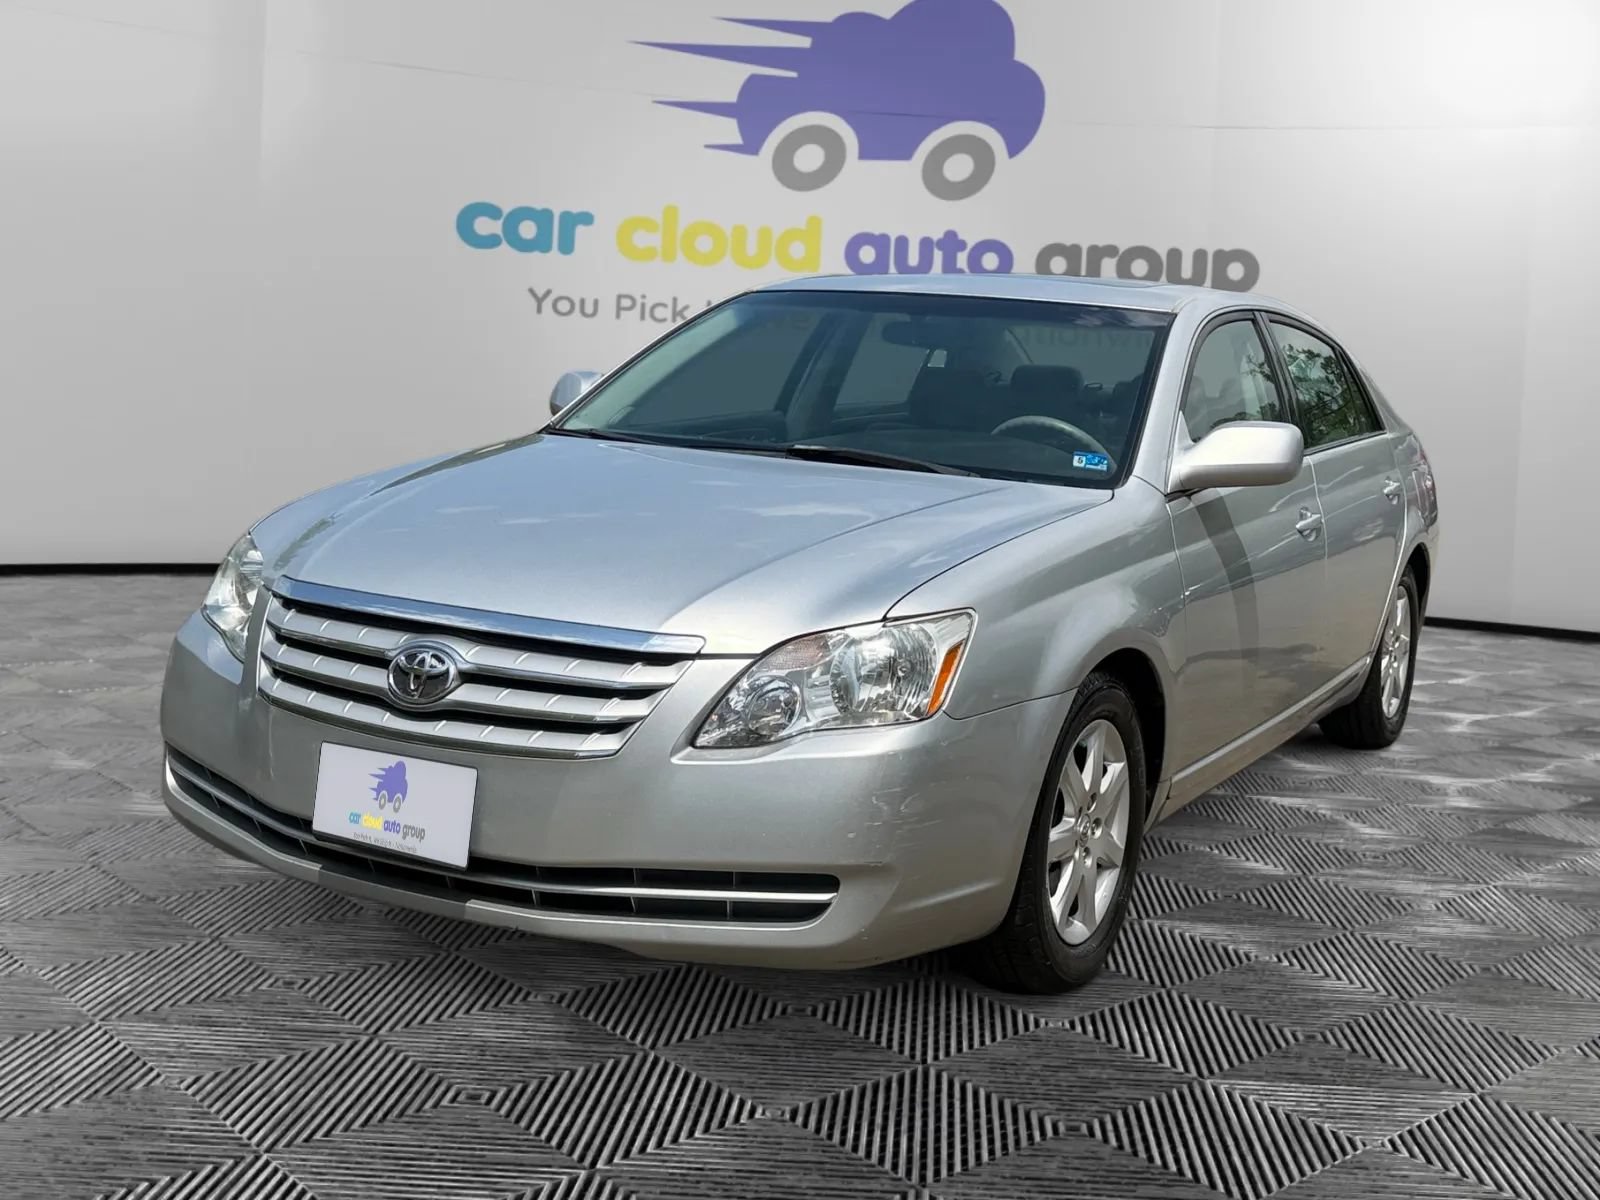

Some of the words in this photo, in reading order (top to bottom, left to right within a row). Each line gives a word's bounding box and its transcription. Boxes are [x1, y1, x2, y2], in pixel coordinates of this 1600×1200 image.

[456, 201, 594, 256] car
[615, 204, 823, 273] cloud
[844, 229, 1014, 275] auto
[528, 287, 599, 318] You
[615, 293, 690, 323] Pick
[349, 812, 361, 825] car
[383, 820, 401, 834] auto
[402, 824, 426, 843] group
